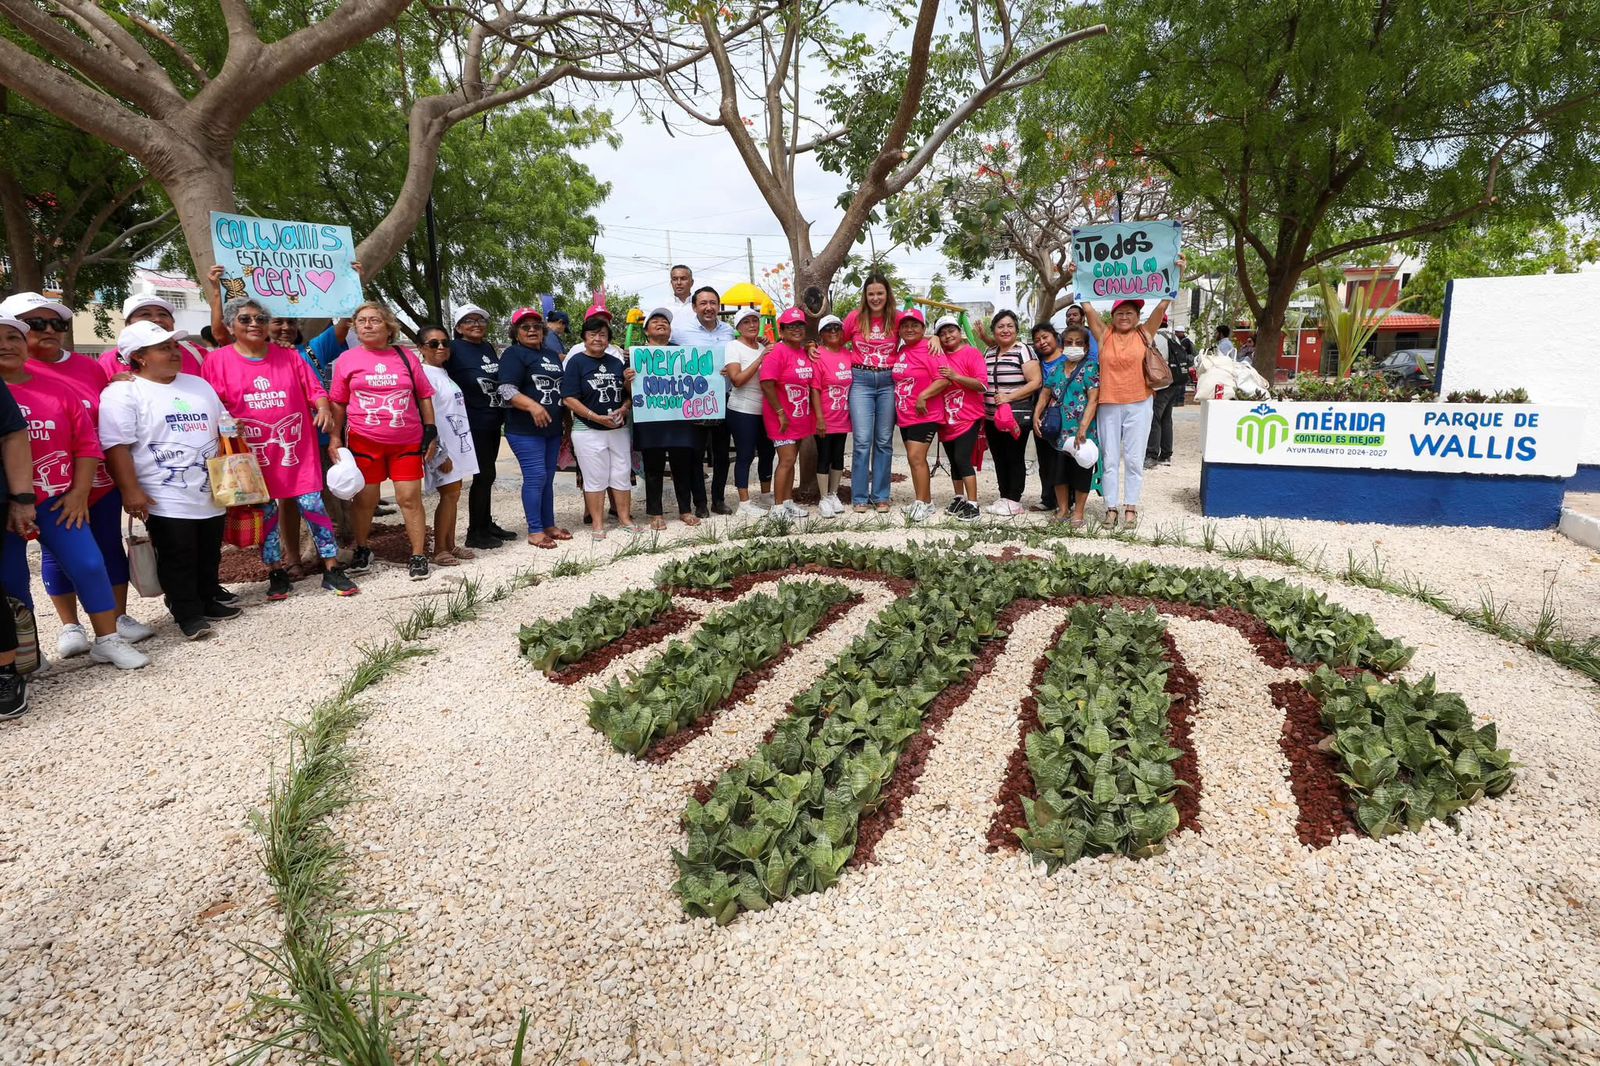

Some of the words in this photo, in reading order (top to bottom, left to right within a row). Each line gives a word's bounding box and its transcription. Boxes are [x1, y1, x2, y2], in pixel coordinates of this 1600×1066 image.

[272, 252, 334, 269] CONTIGO
[171, 423, 209, 432] ENCHULA
[1295, 407, 1386, 433] MÉRIDA
[1424, 412, 1504, 431] PARQUE
[1514, 413, 1540, 428] DE
[1294, 433, 1333, 444] CONTIGO
[1335, 435, 1347, 444] ES
[1349, 436, 1382, 446] MEJOR
[1409, 433, 1538, 462] WALLIS
[1286, 446, 1345, 456] AYUNTAMIENTO
[1347, 448, 1389, 457] 2024-2027
